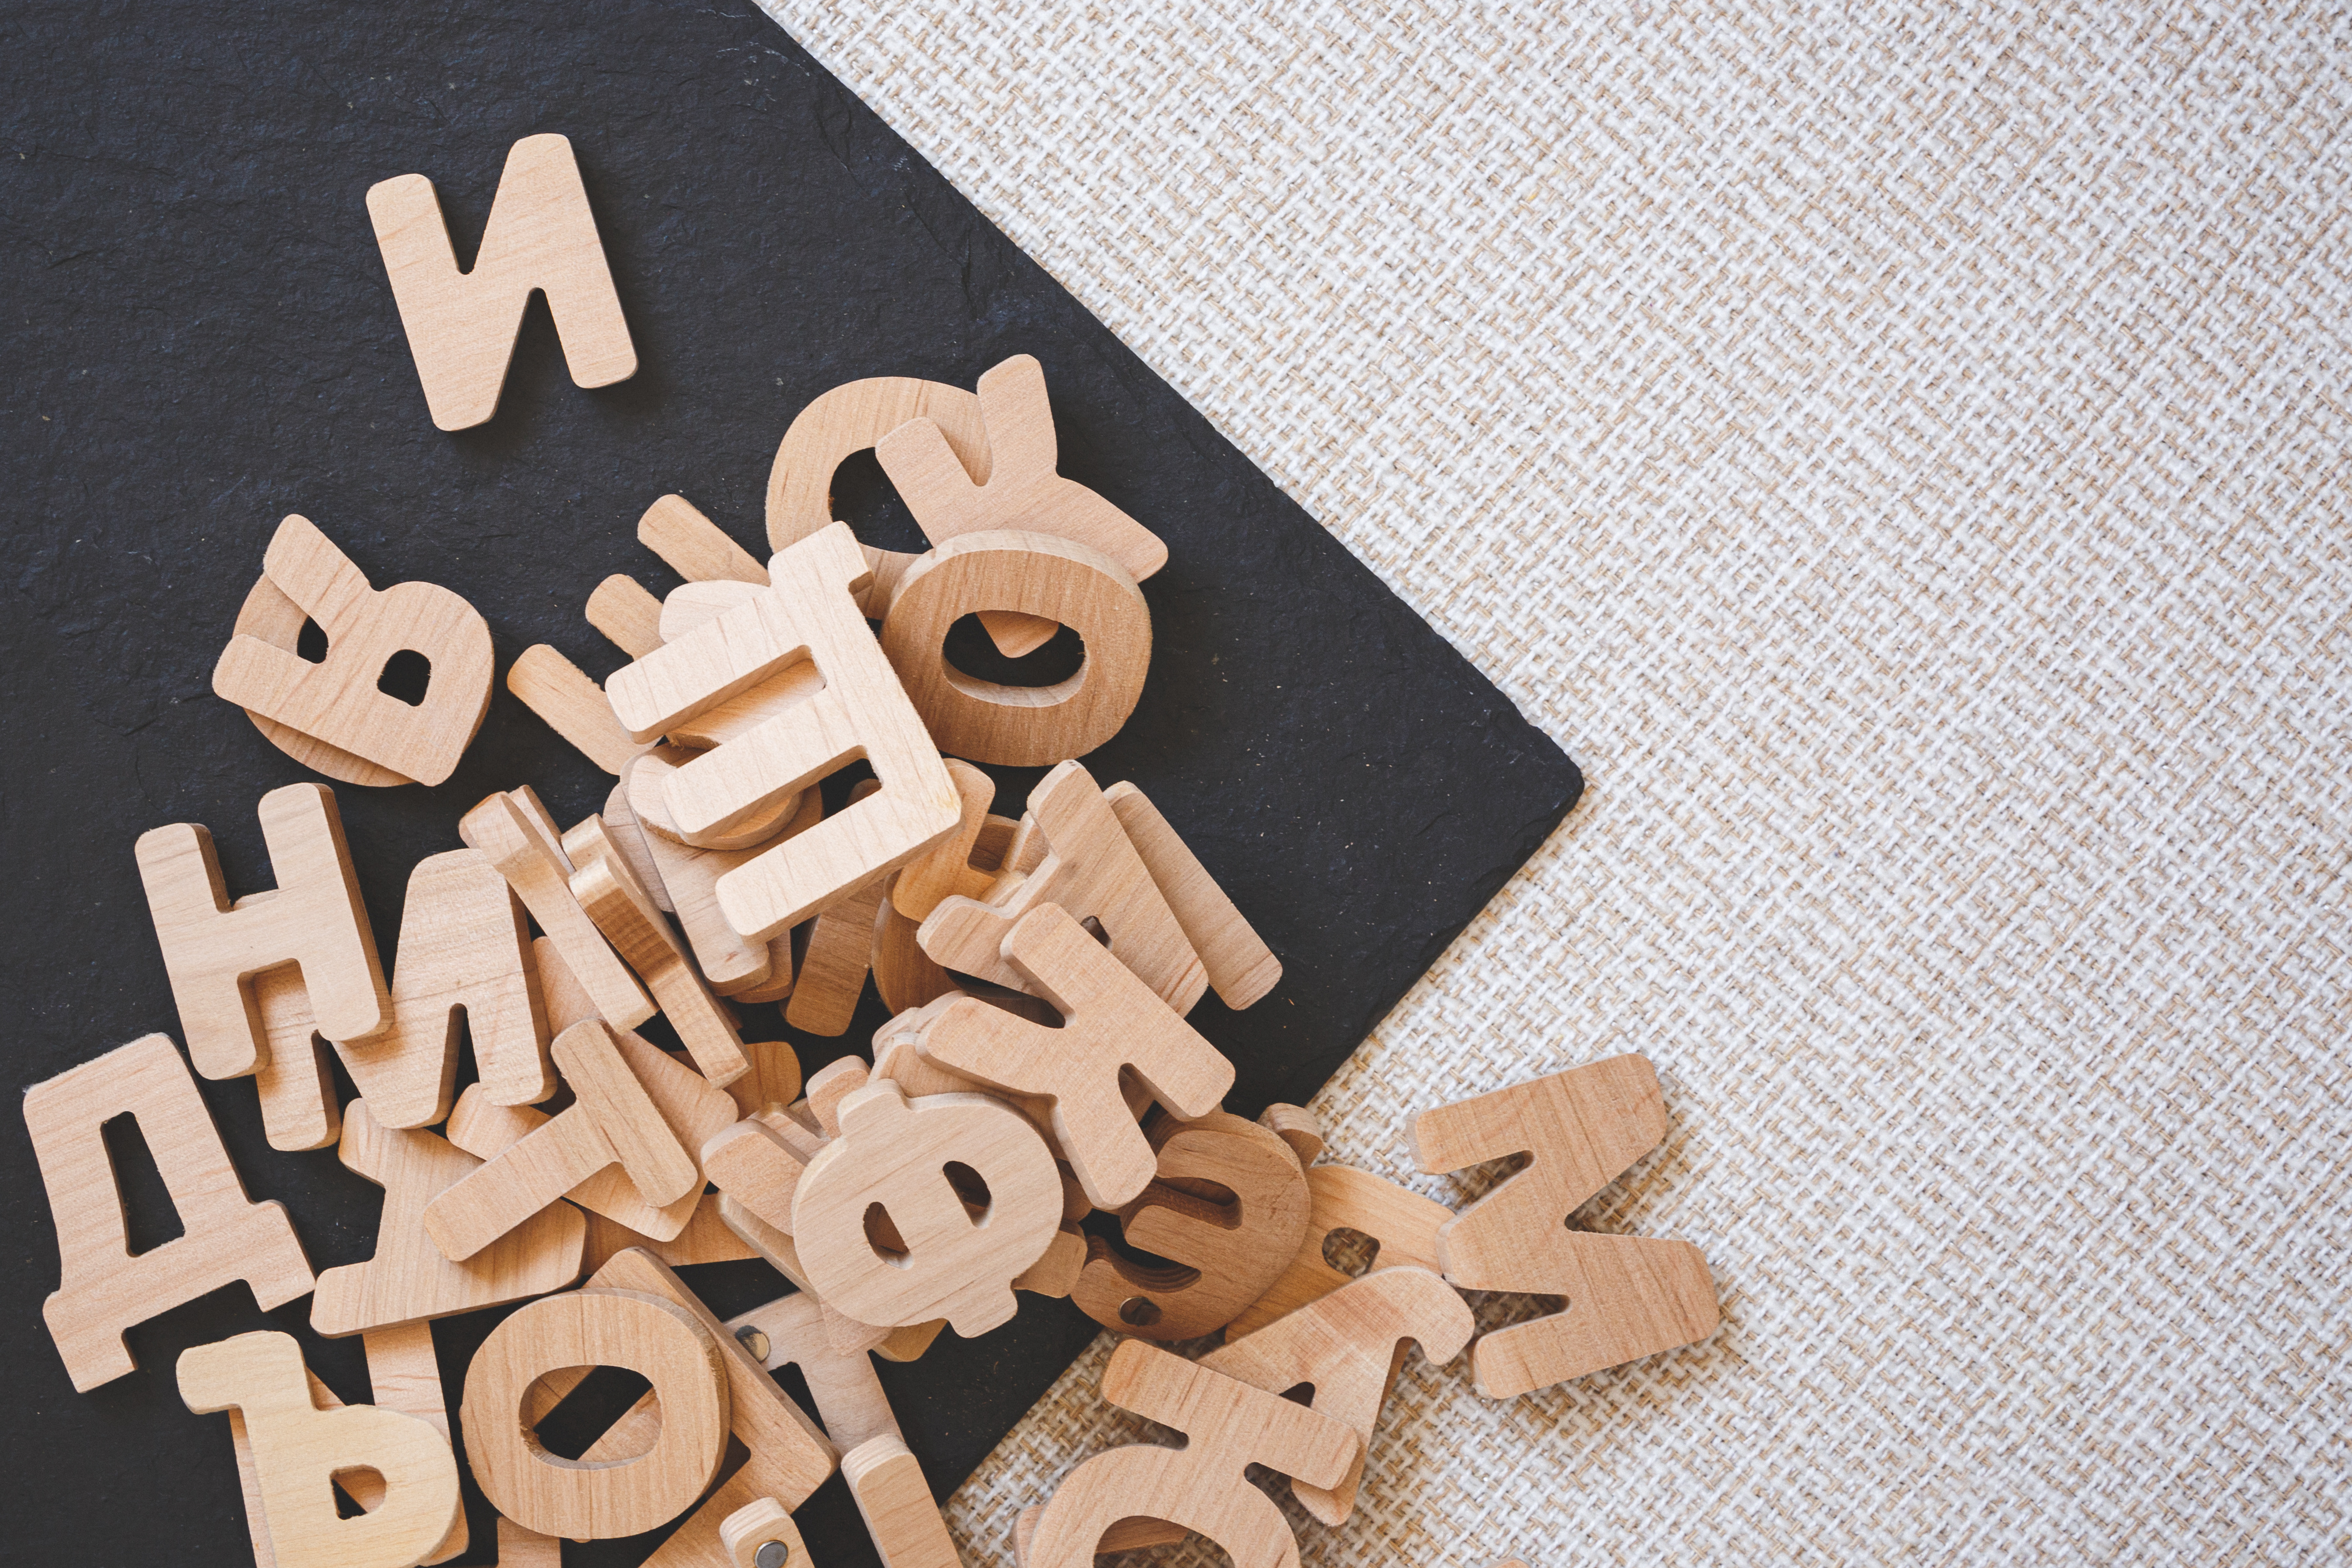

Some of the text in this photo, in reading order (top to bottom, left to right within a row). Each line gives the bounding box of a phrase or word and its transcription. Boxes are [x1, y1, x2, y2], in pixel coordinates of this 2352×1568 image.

[365, 133, 638, 432] И
[212, 514, 494, 786] Я
[605, 521, 962, 944] Щ
[882, 530, 1153, 767] О
[135, 783, 393, 1080] Н
[915, 901, 1236, 1209] К
[23, 1031, 317, 1393] Д
[424, 1018, 699, 1262] Т
[792, 1078, 1064, 1339] Ф
[1407, 1052, 1720, 1400] М
[175, 1330, 460, 1568] Ъ
[460, 1287, 731, 1540] О
